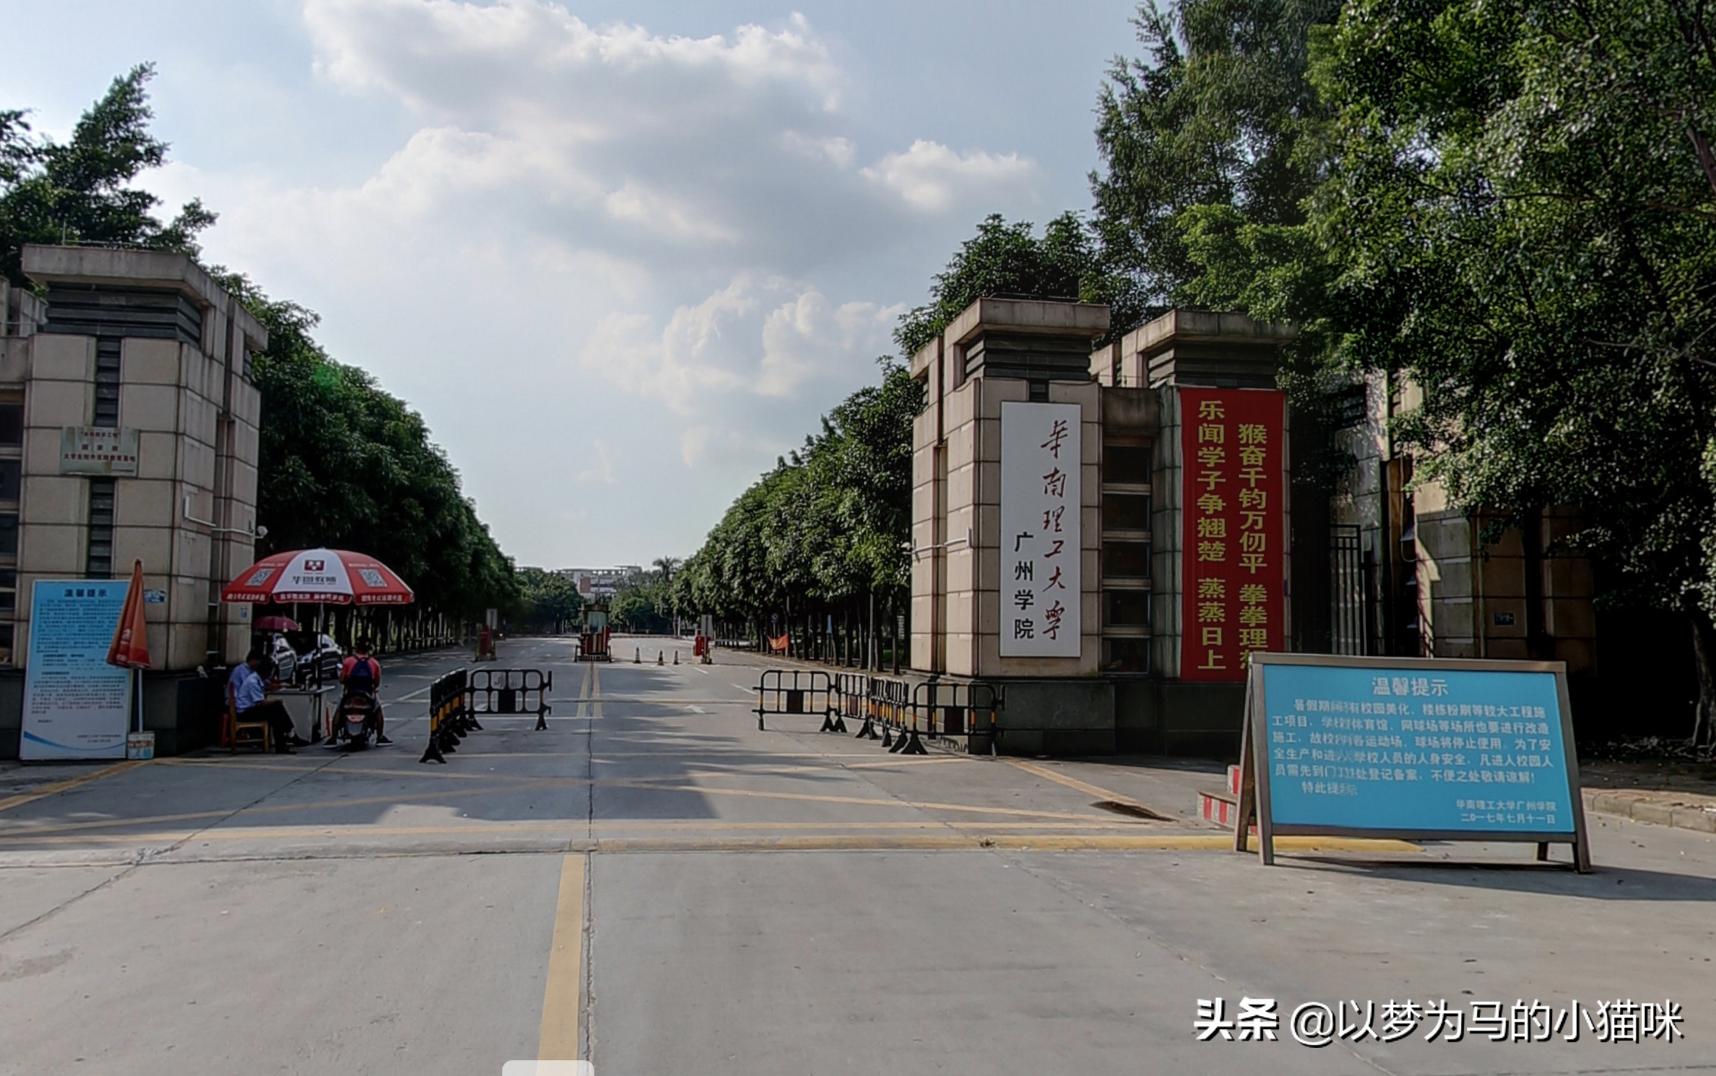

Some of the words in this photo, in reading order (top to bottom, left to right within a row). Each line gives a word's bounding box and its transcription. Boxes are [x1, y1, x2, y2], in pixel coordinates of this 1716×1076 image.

[1197, 400, 1226, 562] 乐闻学子争翘楚
[1238, 423, 1267, 574] 猴奋千钧万仞平
[1014, 531, 1034, 640] 广州学院
[1198, 577, 1226, 670] 蒸蒸日上
[1371, 676, 1449, 697] 温馨提示
[1456, 799, 1558, 812] 华南理工大学广州学院
